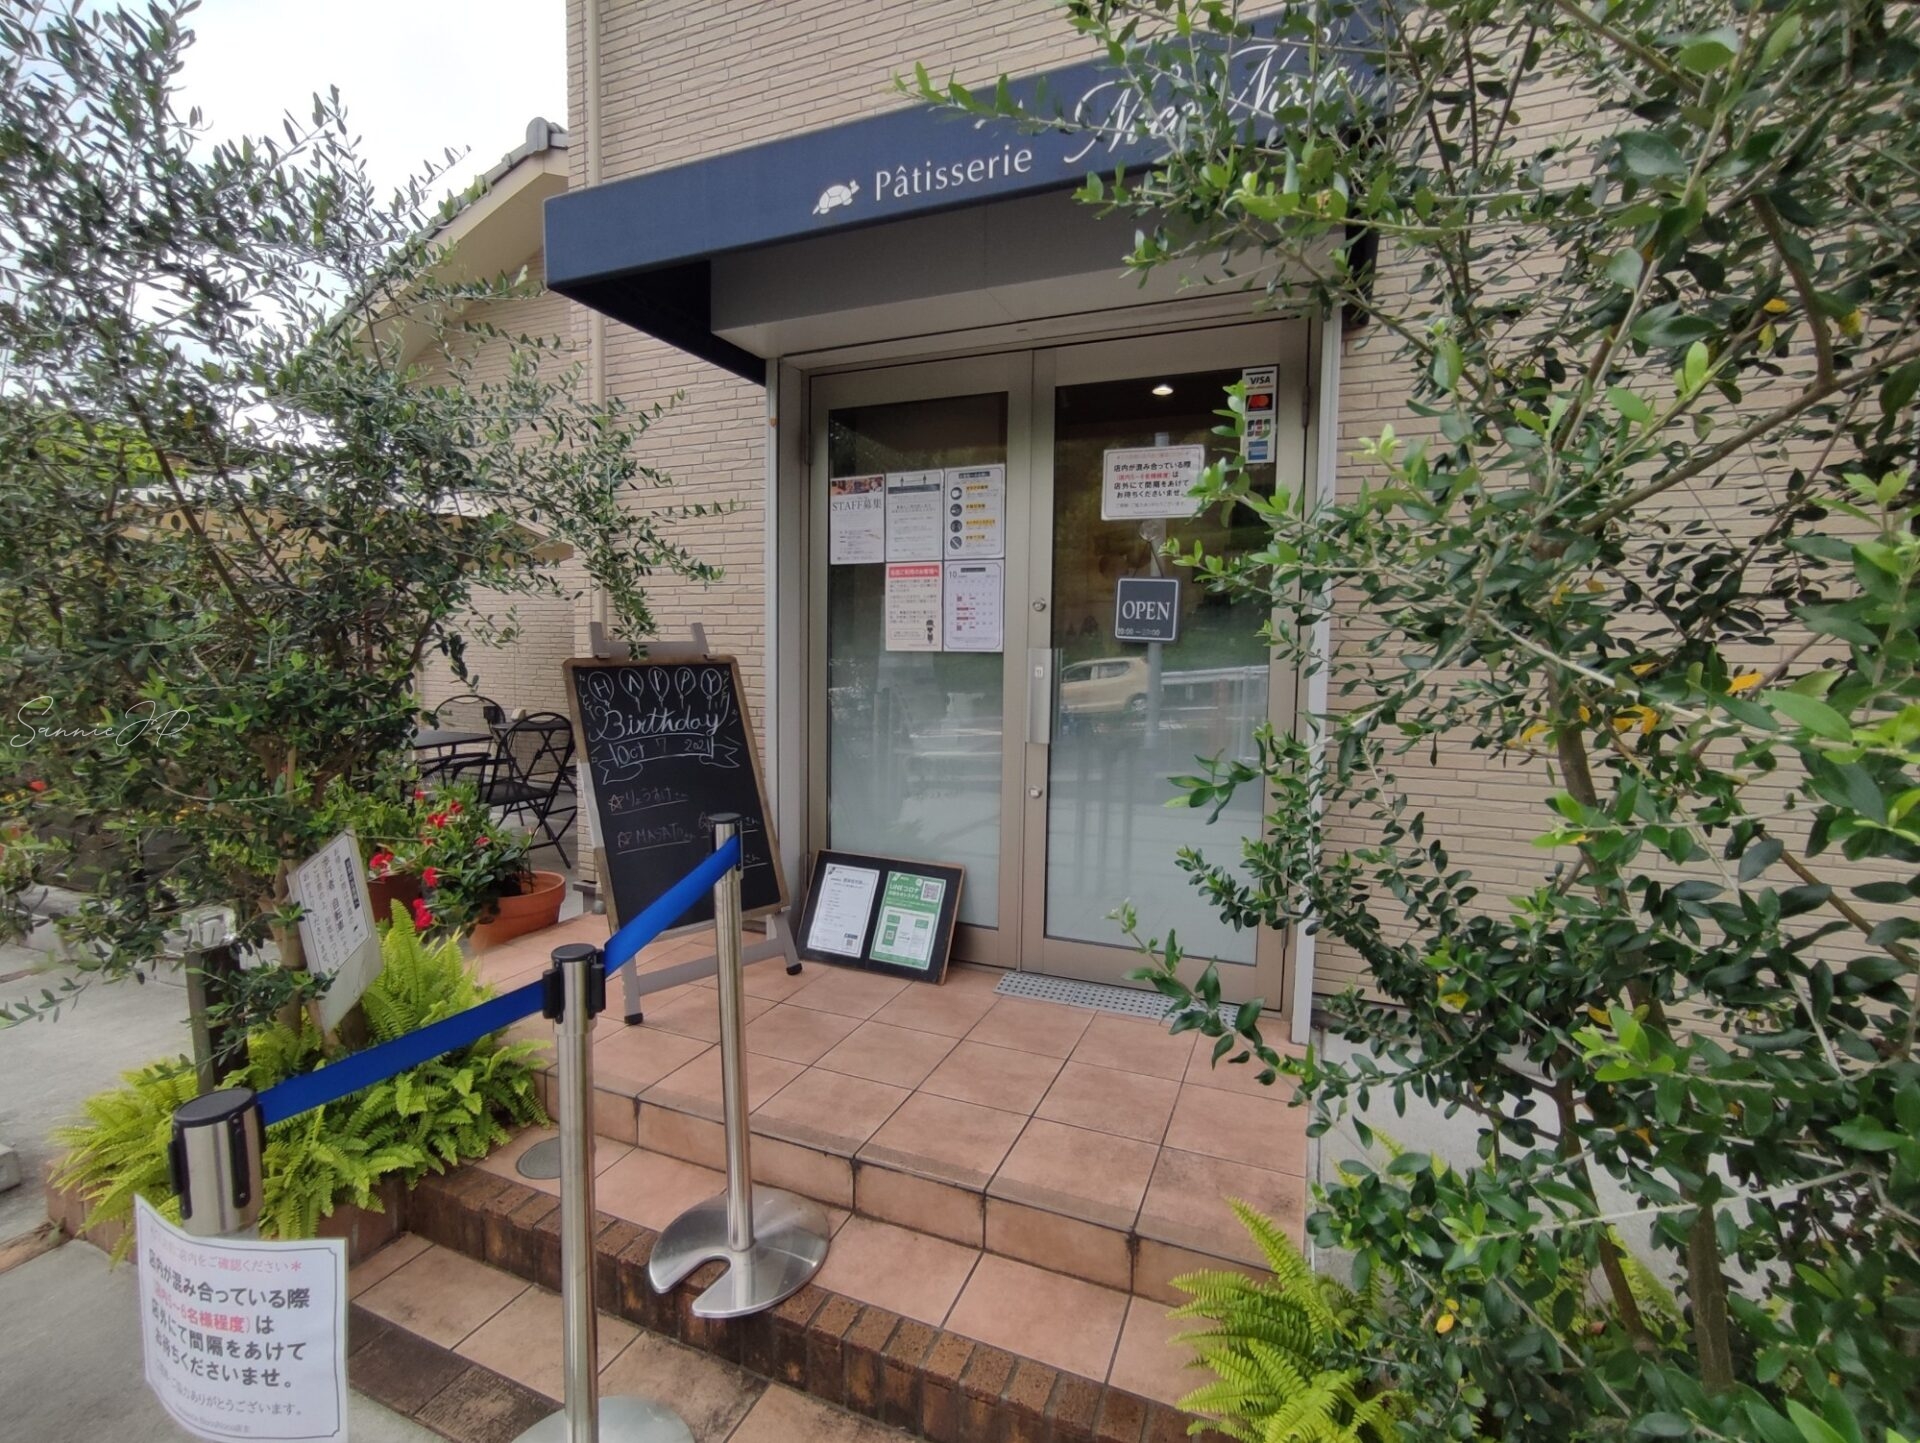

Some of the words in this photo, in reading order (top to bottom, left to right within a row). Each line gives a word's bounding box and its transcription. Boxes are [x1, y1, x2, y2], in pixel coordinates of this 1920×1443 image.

[876, 144, 1033, 200] Pâtisserie
[1250, 375, 1271, 385] VISA
[1122, 600, 1170, 620] OPEN
[593, 669, 717, 698] HAPPY
[589, 704, 720, 741] Birthday
[149, 1248, 310, 1310] 店内が混み合っている際
[151, 1298, 307, 1362] 店外にて間隔をあけて
[154, 1328, 293, 1389] お待ちくださいませ。
